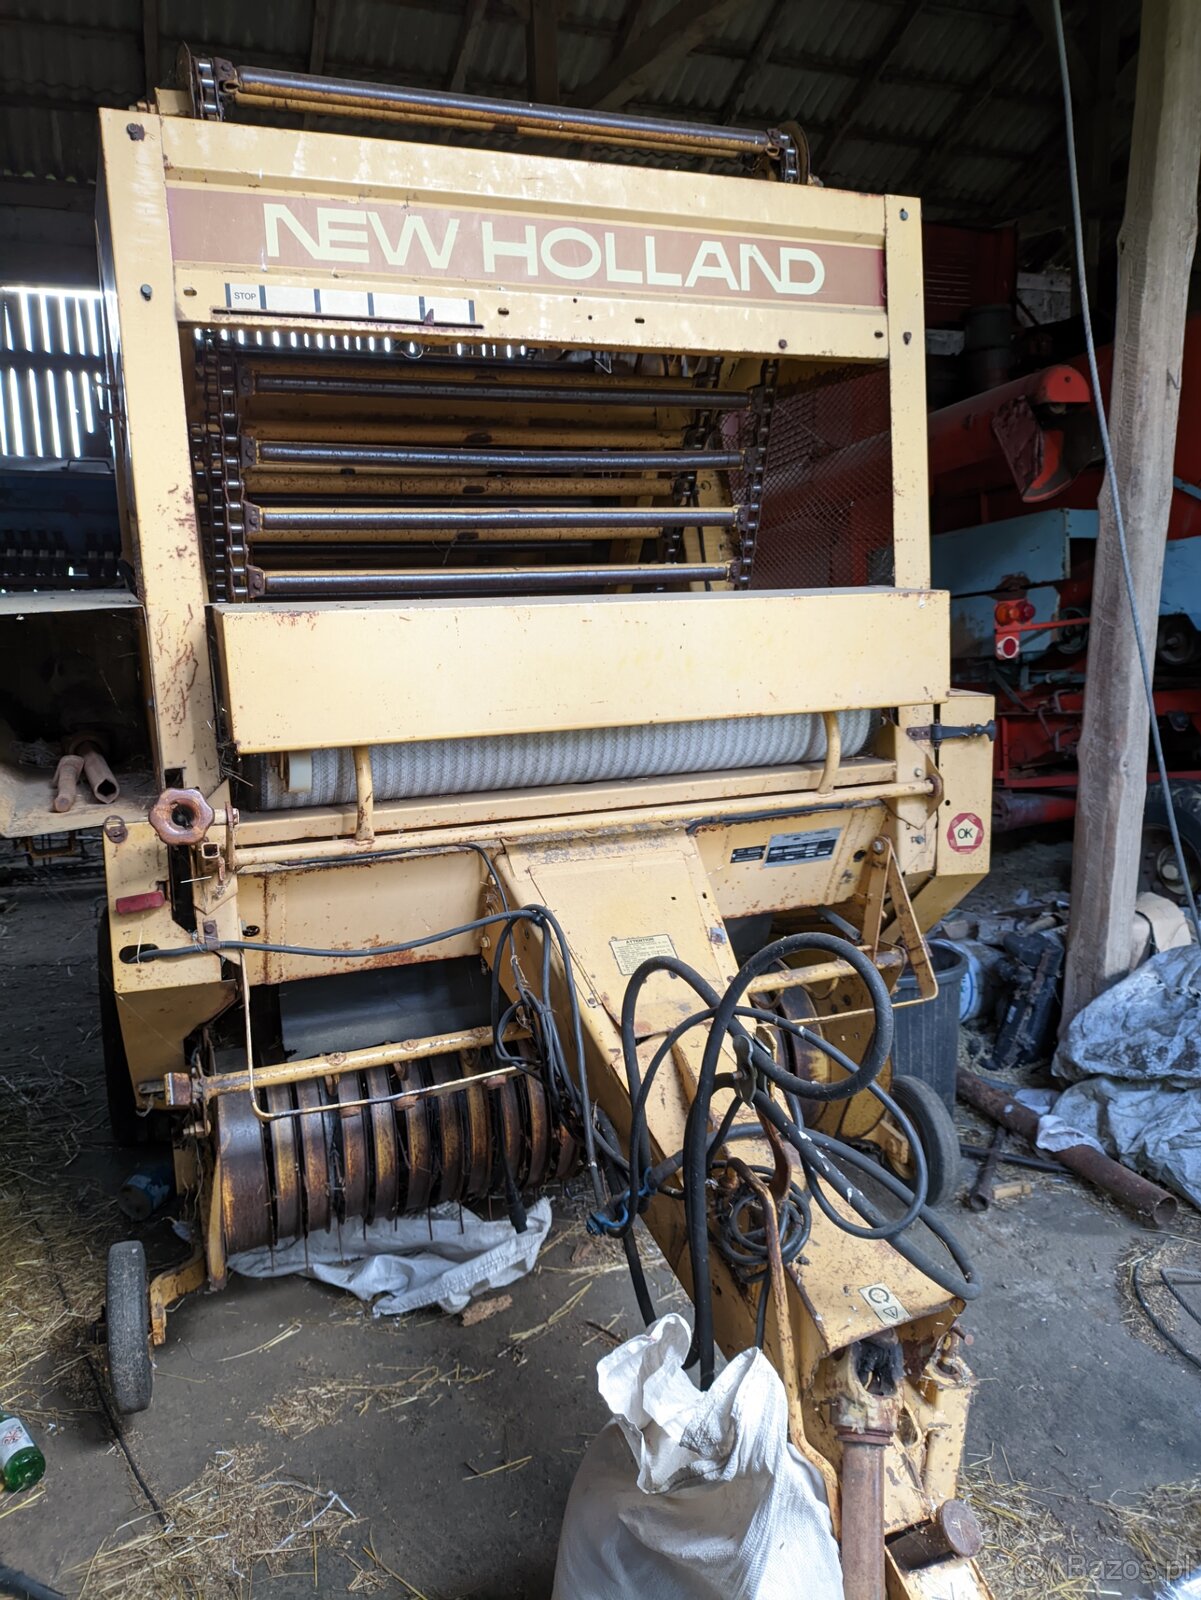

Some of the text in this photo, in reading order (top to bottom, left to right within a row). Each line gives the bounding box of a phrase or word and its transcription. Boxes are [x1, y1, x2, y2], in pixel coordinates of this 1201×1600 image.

[263, 203, 825, 295] NEW HOLLAND
[234, 291, 257, 301] STOP
[957, 827, 973, 839] OK
